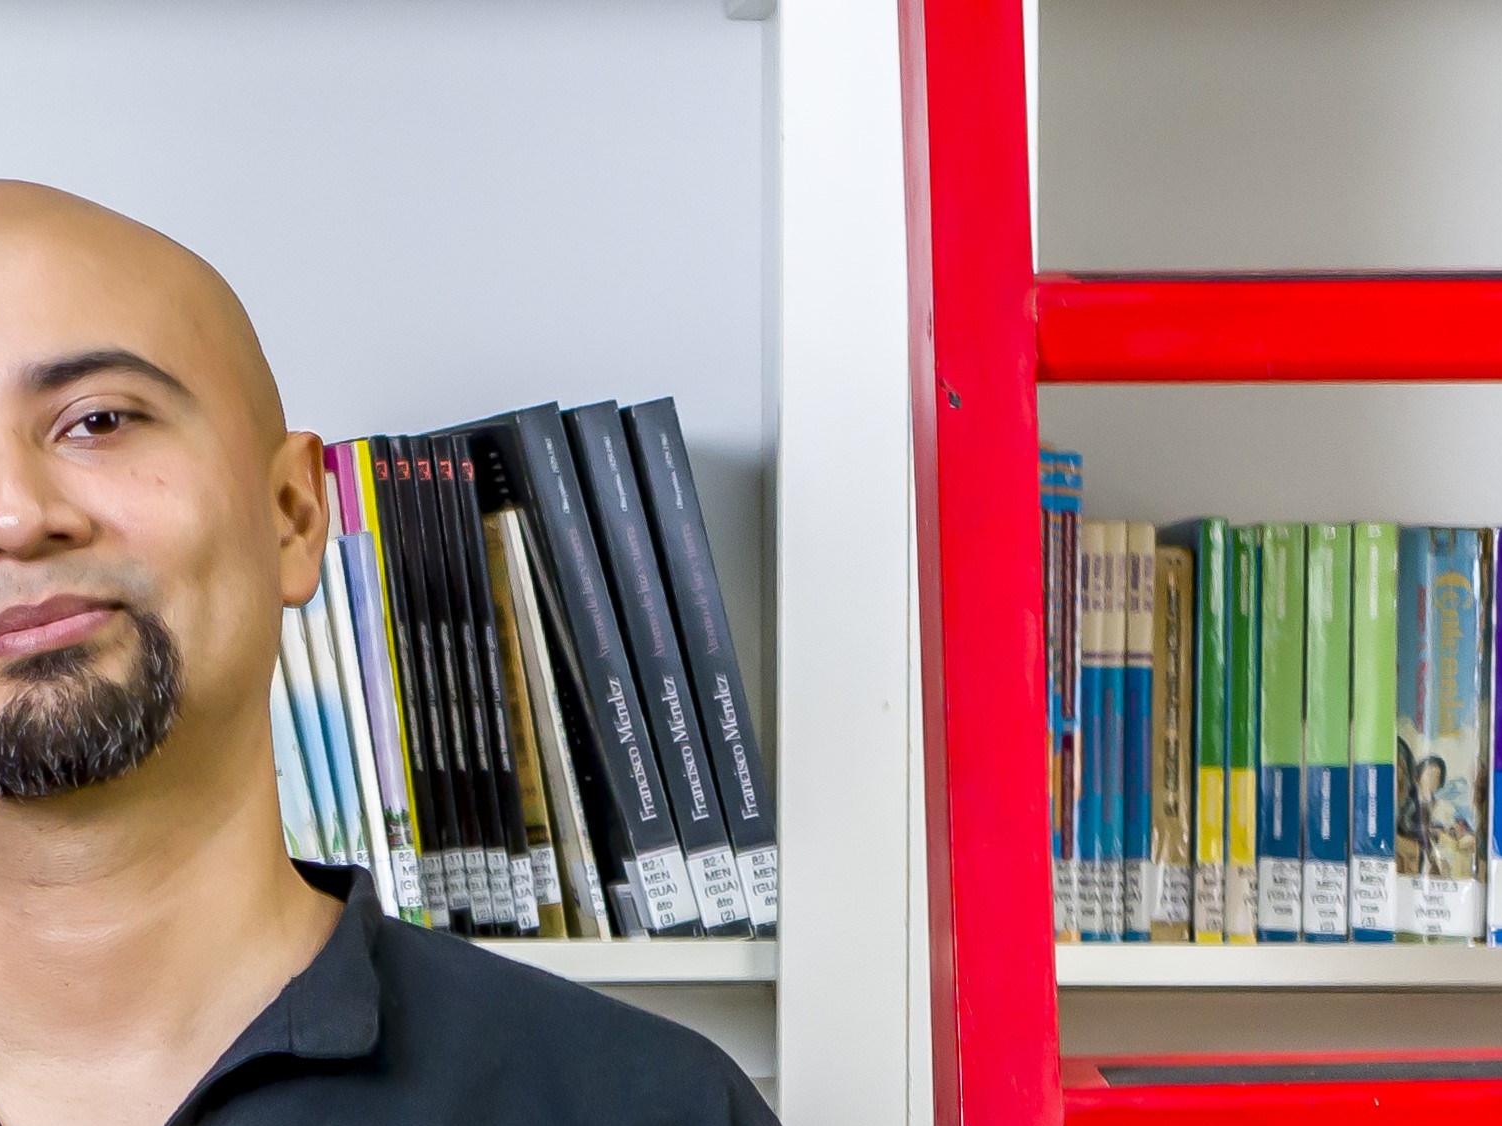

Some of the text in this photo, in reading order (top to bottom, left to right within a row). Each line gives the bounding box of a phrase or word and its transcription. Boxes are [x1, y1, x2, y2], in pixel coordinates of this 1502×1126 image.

[625, 746, 657, 822] Francisco
[679, 746, 711, 822] Francisco
[731, 744, 763, 821] Francisco
[642, 857, 665, 872] 82-1
[702, 855, 726, 868] 82-1
[644, 872, 671, 885] MEN
[704, 868, 731, 882] MEN
[704, 880, 739, 898] (GUA)
[660, 914, 676, 928] (3)
[720, 911, 736, 926] (2)
